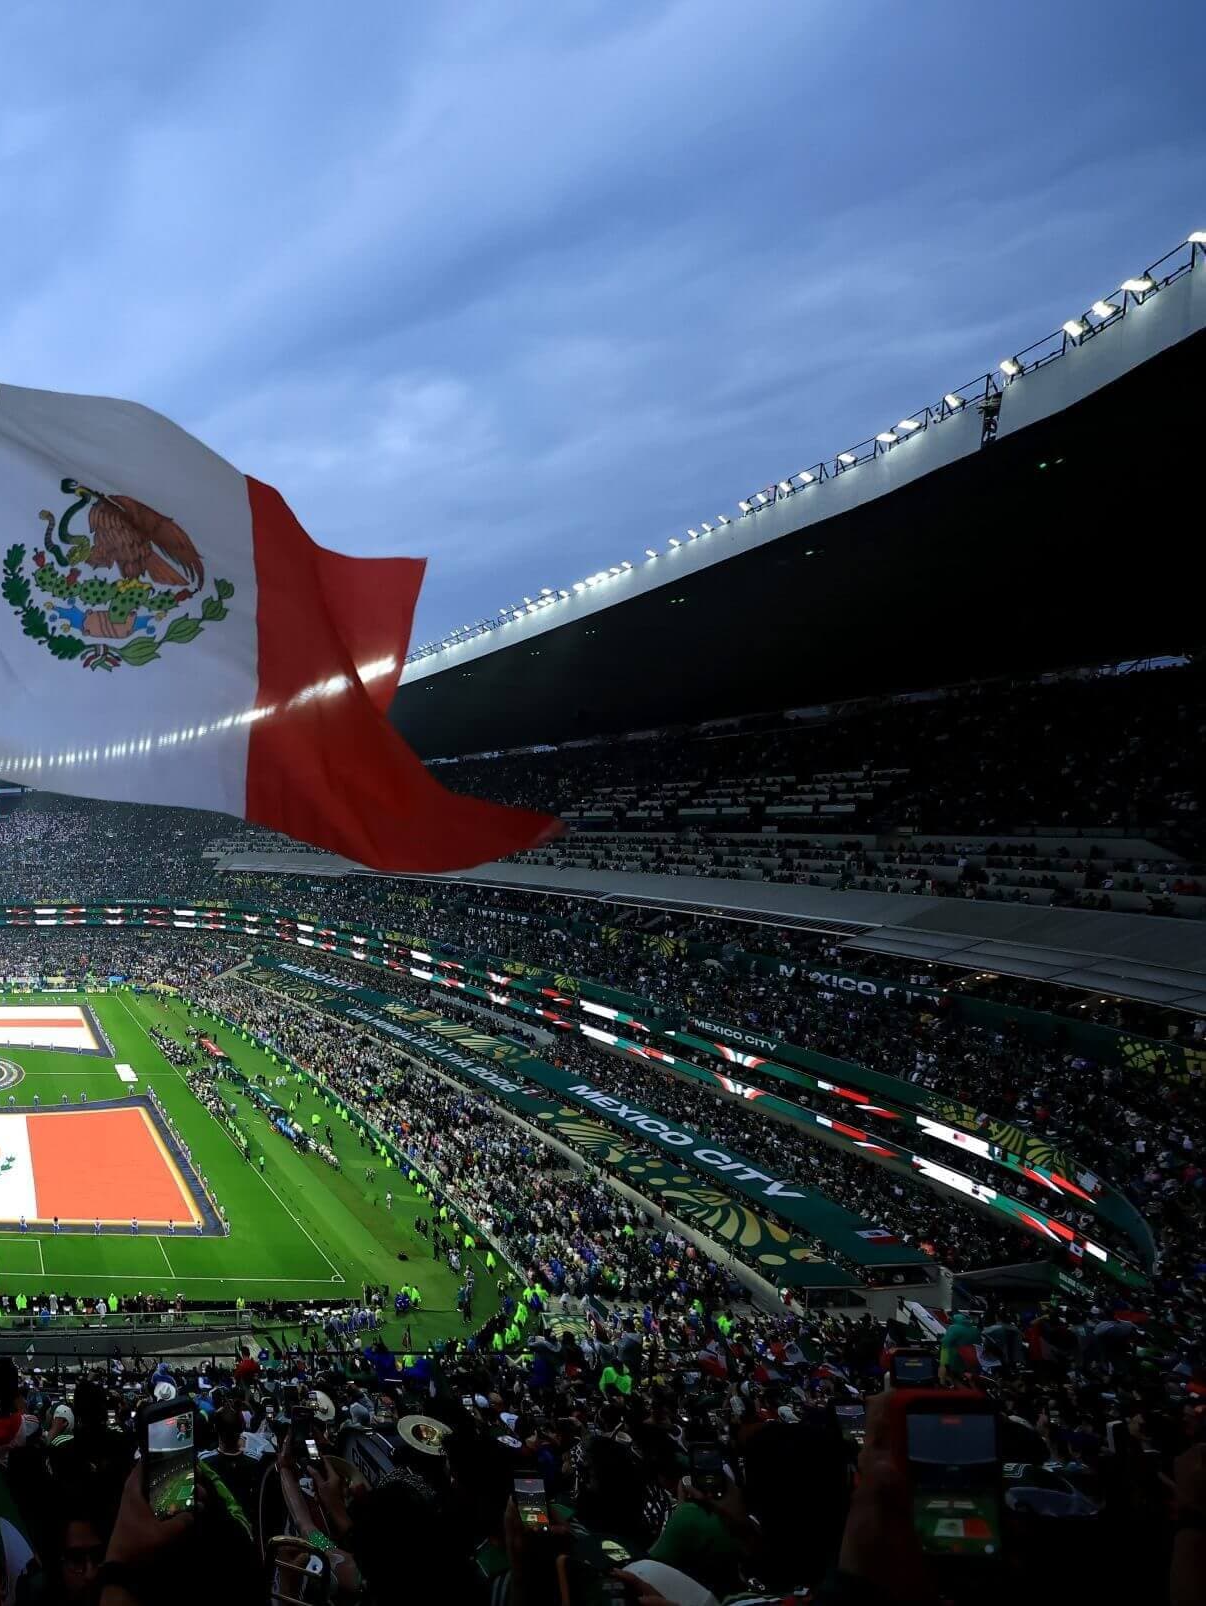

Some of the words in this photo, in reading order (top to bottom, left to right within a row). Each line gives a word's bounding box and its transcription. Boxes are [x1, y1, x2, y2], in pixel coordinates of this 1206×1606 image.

[278, 963, 326, 981] MEXICO
[346, 1008, 374, 1021] COPA
[371, 1018, 416, 1041] MUNDIAL
[412, 1038, 430, 1048] DE
[426, 1045, 445, 1057] LA
[442, 1052, 474, 1068] FIFA
[467, 1066, 521, 1093] 2026
[694, 1018, 743, 1040] MEXICO
[745, 1035, 777, 1051] CITY
[567, 1084, 695, 1146] MEXICO
[692, 1148, 807, 1199] CITY
